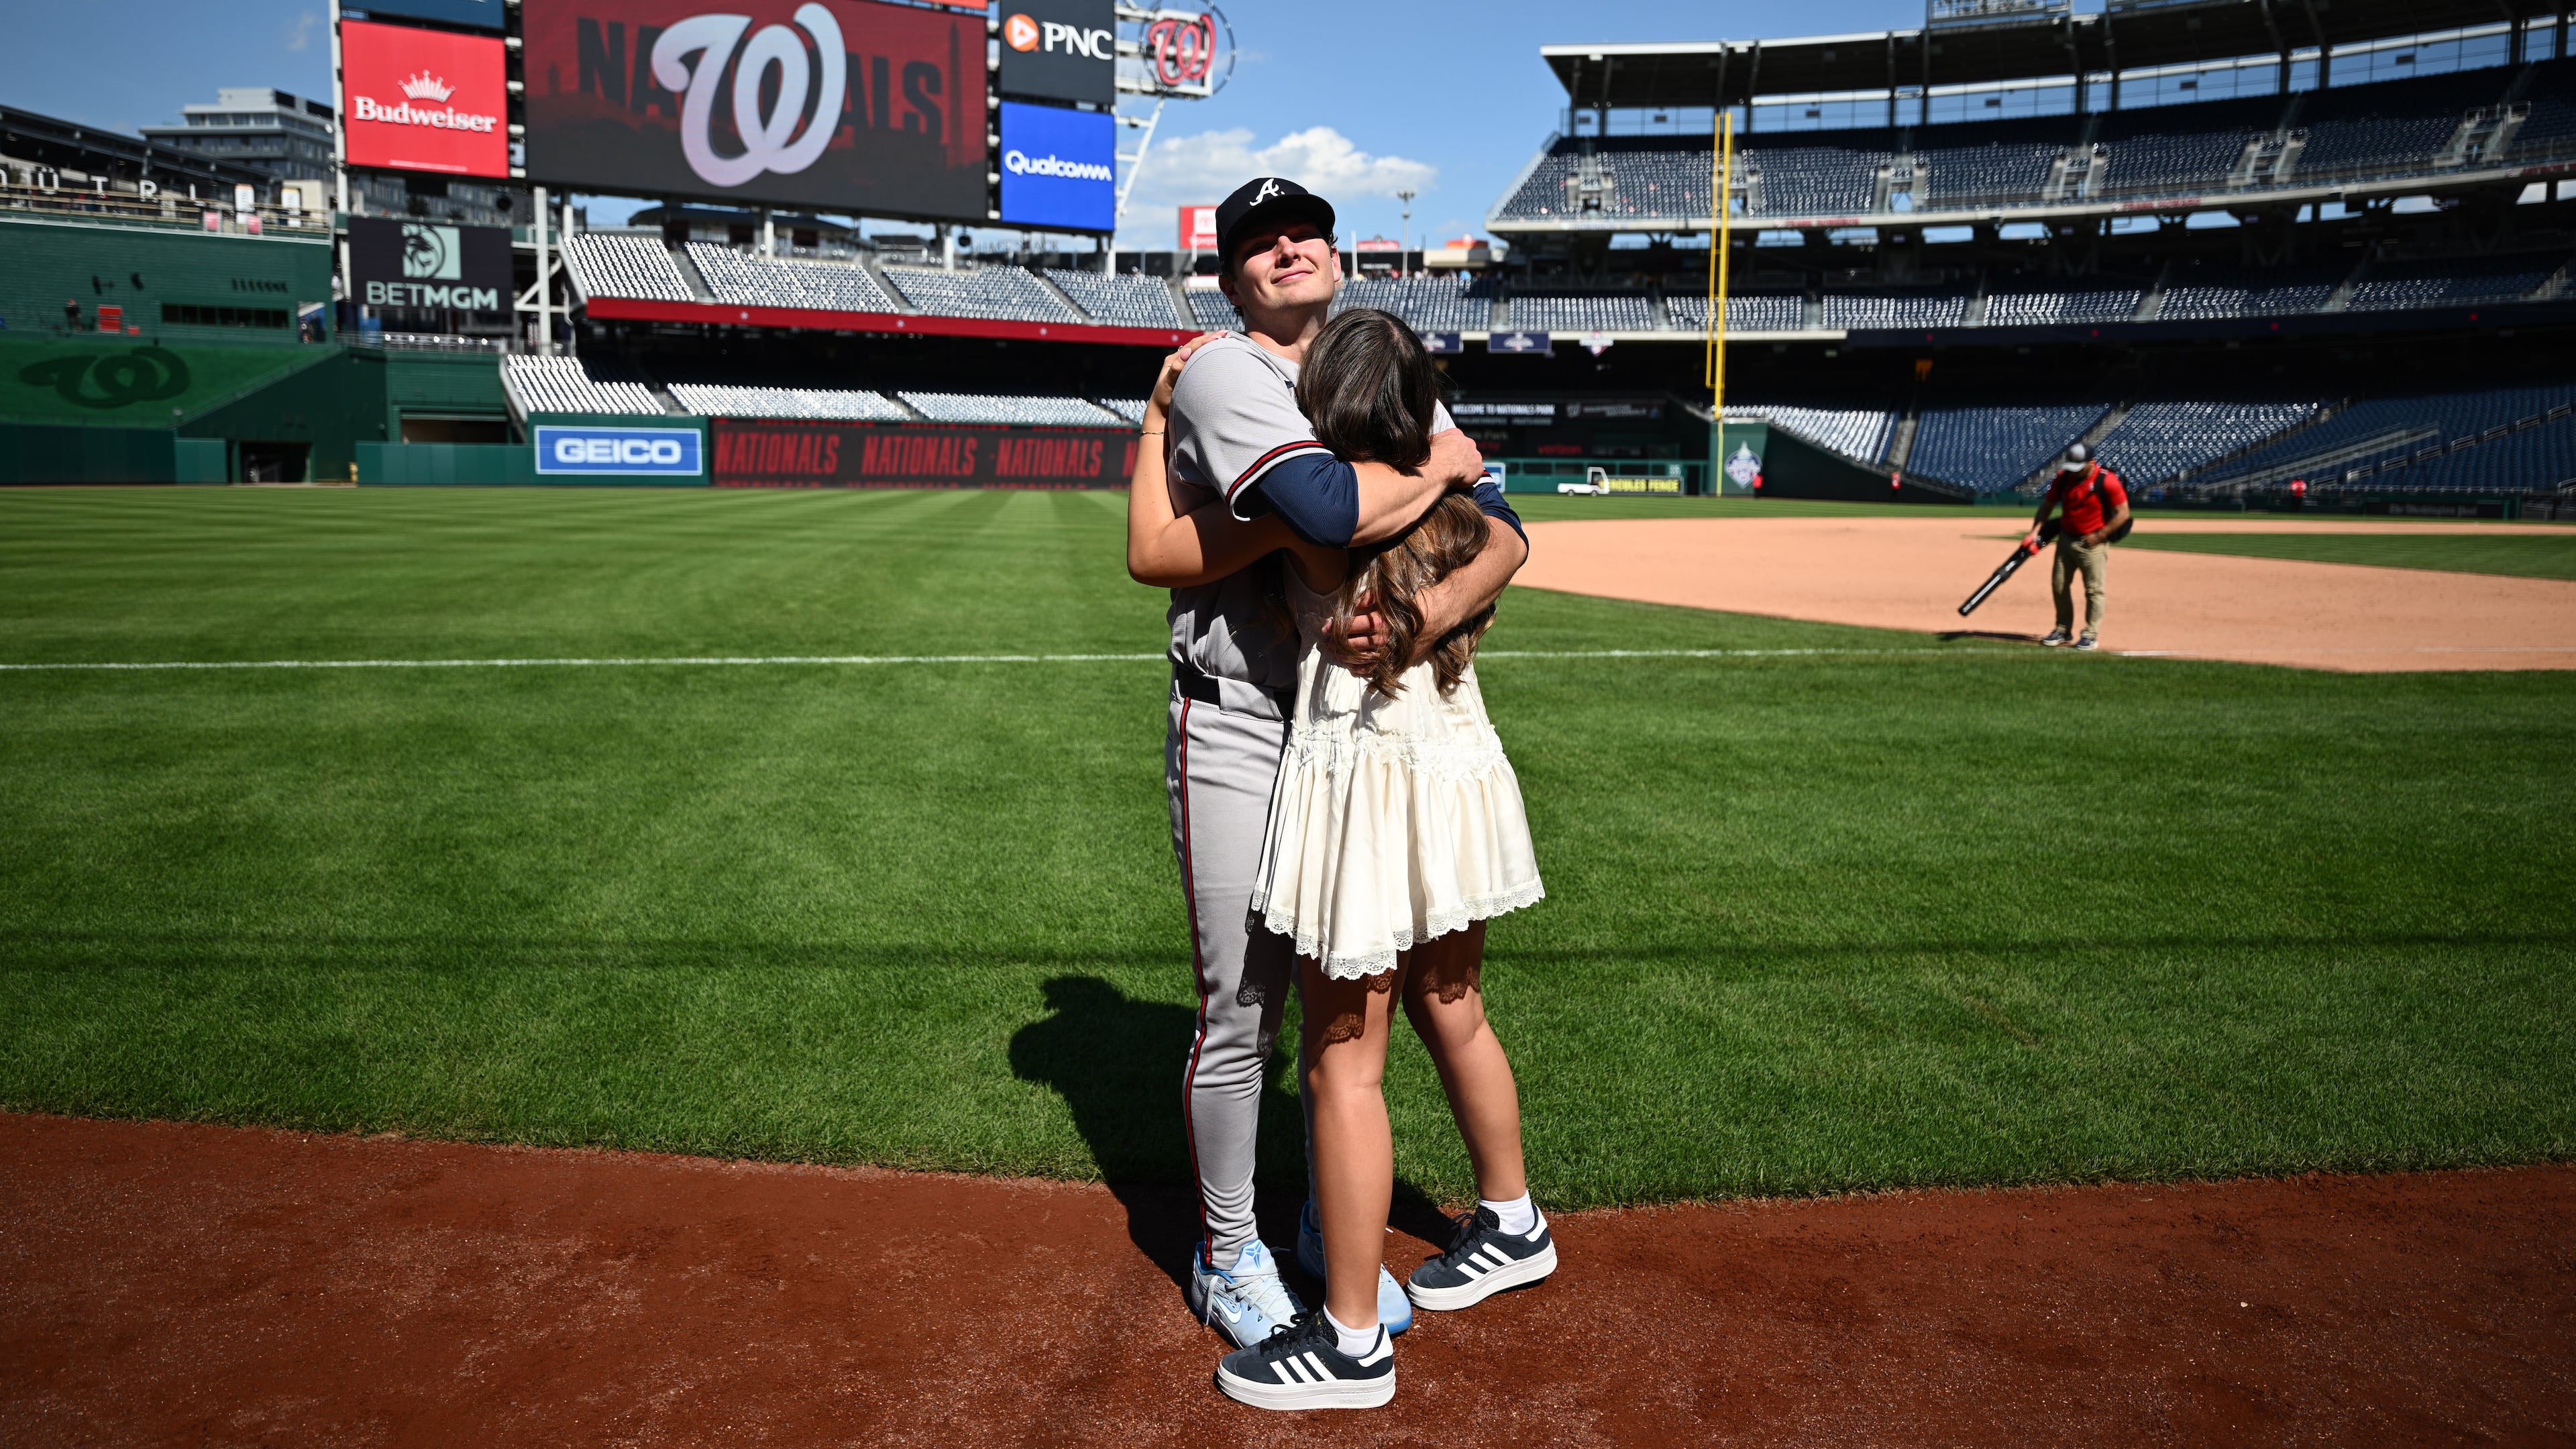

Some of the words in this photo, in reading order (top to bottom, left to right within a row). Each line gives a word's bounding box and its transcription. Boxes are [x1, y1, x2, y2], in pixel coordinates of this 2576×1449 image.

[1042, 21, 1113, 60] PNC
[577, 17, 943, 144] NAALS
[354, 95, 497, 133] Budweiser
[1005, 150, 1112, 182] Qualcomm
[1188, 236, 1217, 246] TOYOT
[366, 280, 498, 311] BETMGM
[1451, 404, 1484, 415] WELCOME
[1486, 404, 1495, 415] TO
[1497, 404, 1534, 415] NATIONALS
[1535, 404, 1555, 415] PARK
[555, 437, 682, 464] GEICO
[715, 432, 841, 474] NATIONALS
[862, 436, 977, 476] NATIONALS
[996, 439, 1103, 476] NATIONALS
